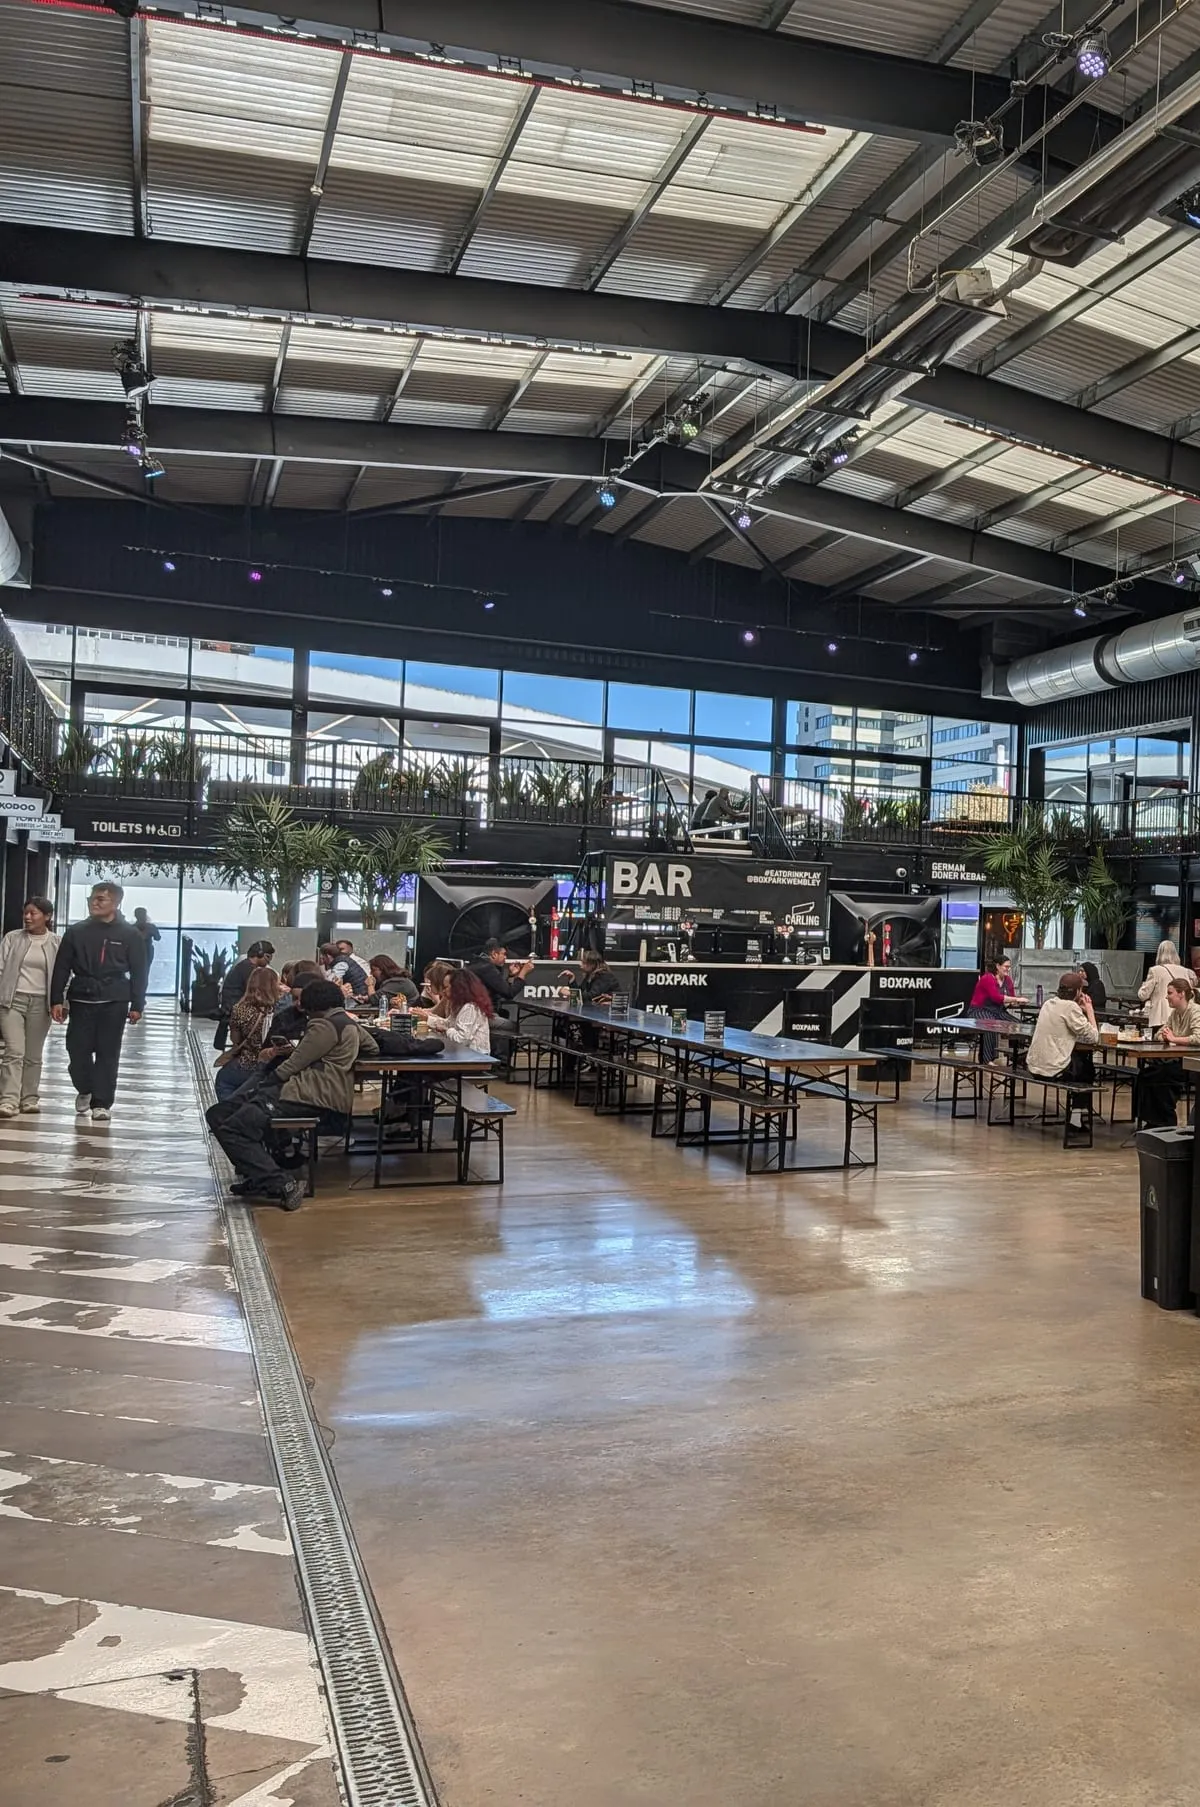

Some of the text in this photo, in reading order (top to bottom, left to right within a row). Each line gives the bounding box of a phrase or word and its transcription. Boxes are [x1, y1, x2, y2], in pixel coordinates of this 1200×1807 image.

[91, 821, 143, 834] TOILETS
[931, 862, 966, 872] GERMAN
[612, 860, 692, 898] BAR
[764, 869, 822, 880] #EATDRINKPLAY
[931, 871, 959, 880] DONER
[746, 875, 821, 887] @BOXPARKWEMBLEY
[785, 914, 820, 926] CARLING
[647, 973, 708, 986] BOXPARK
[879, 977, 932, 989] BOXPARK
[792, 1023, 821, 1032] BOXPARK
